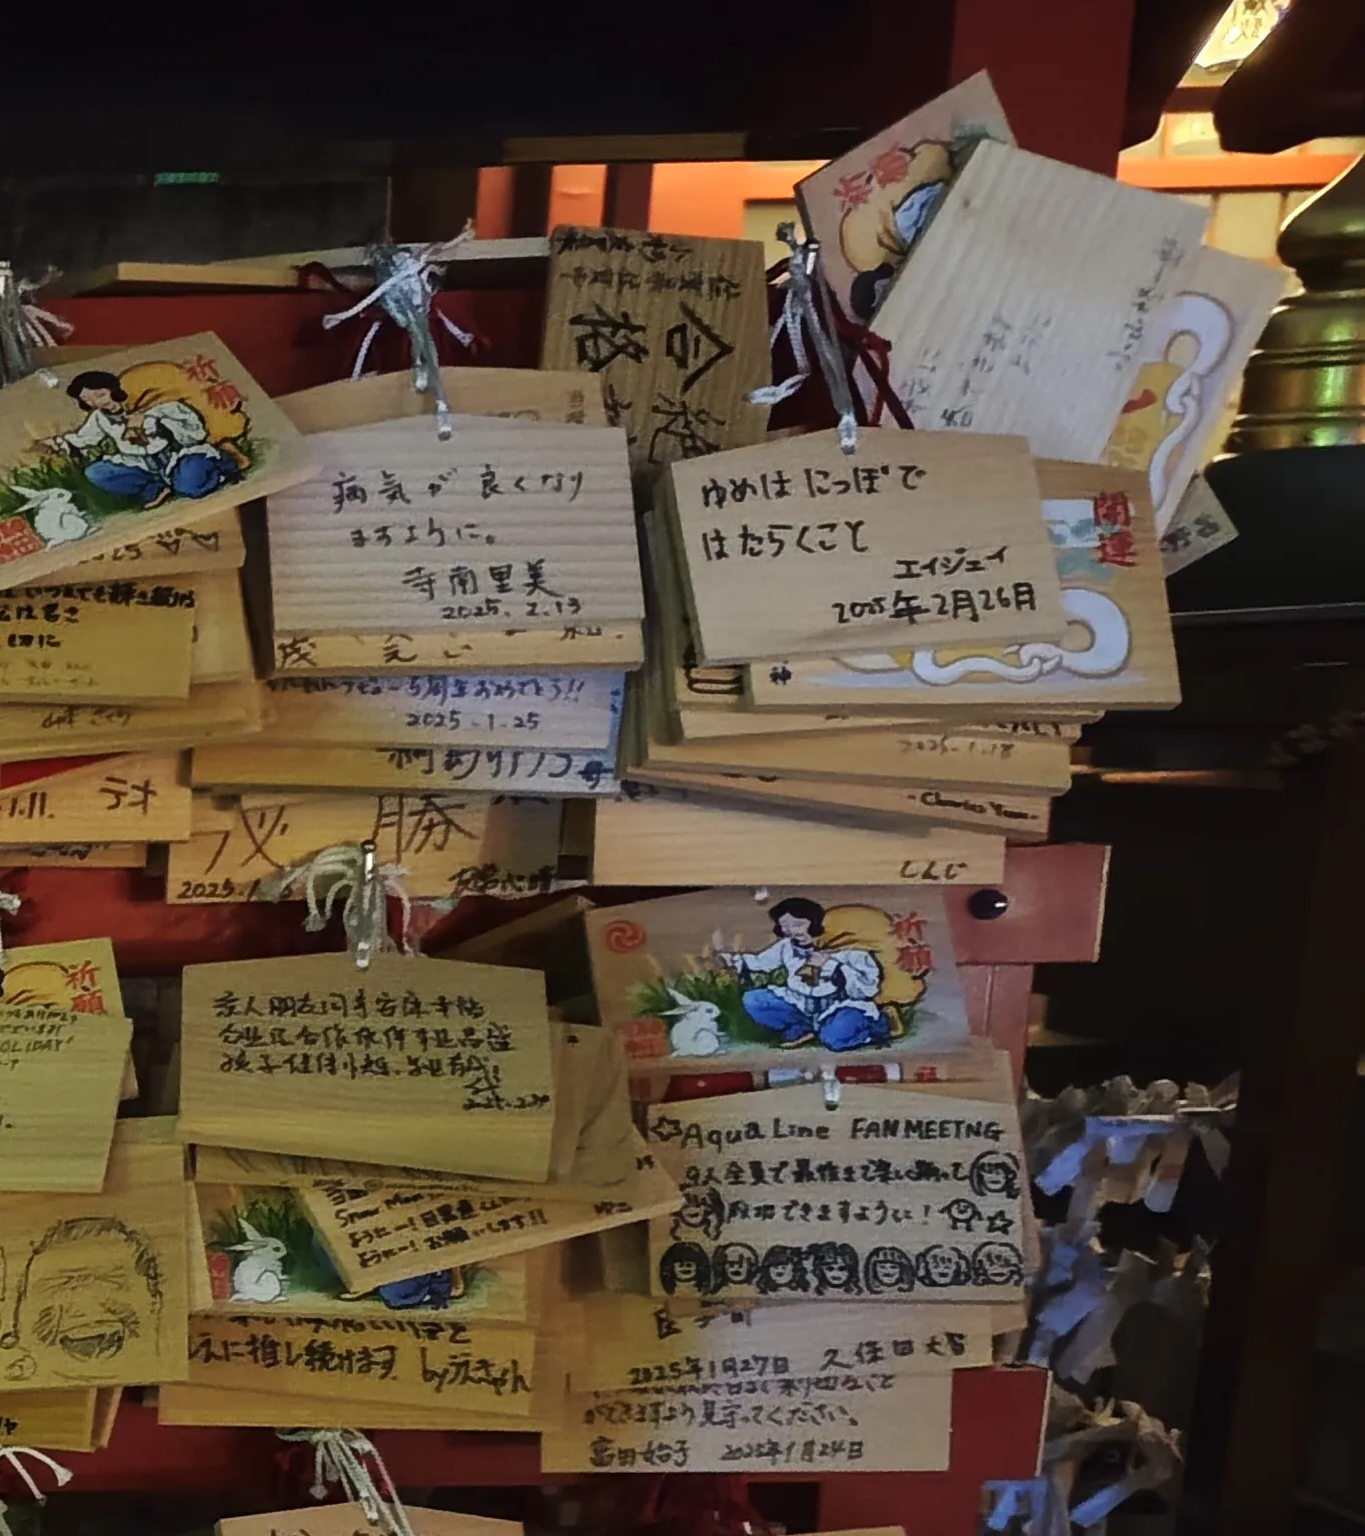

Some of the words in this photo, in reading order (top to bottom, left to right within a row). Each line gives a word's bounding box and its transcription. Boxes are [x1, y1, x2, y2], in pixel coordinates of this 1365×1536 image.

[701, 520, 869, 560] はたらくこと
[894, 547, 1010, 578] エイジェイ
[442, 601, 581, 619] 2025.2.13
[681, 1122, 766, 1153] Aqua
[772, 1119, 830, 1140] Line
